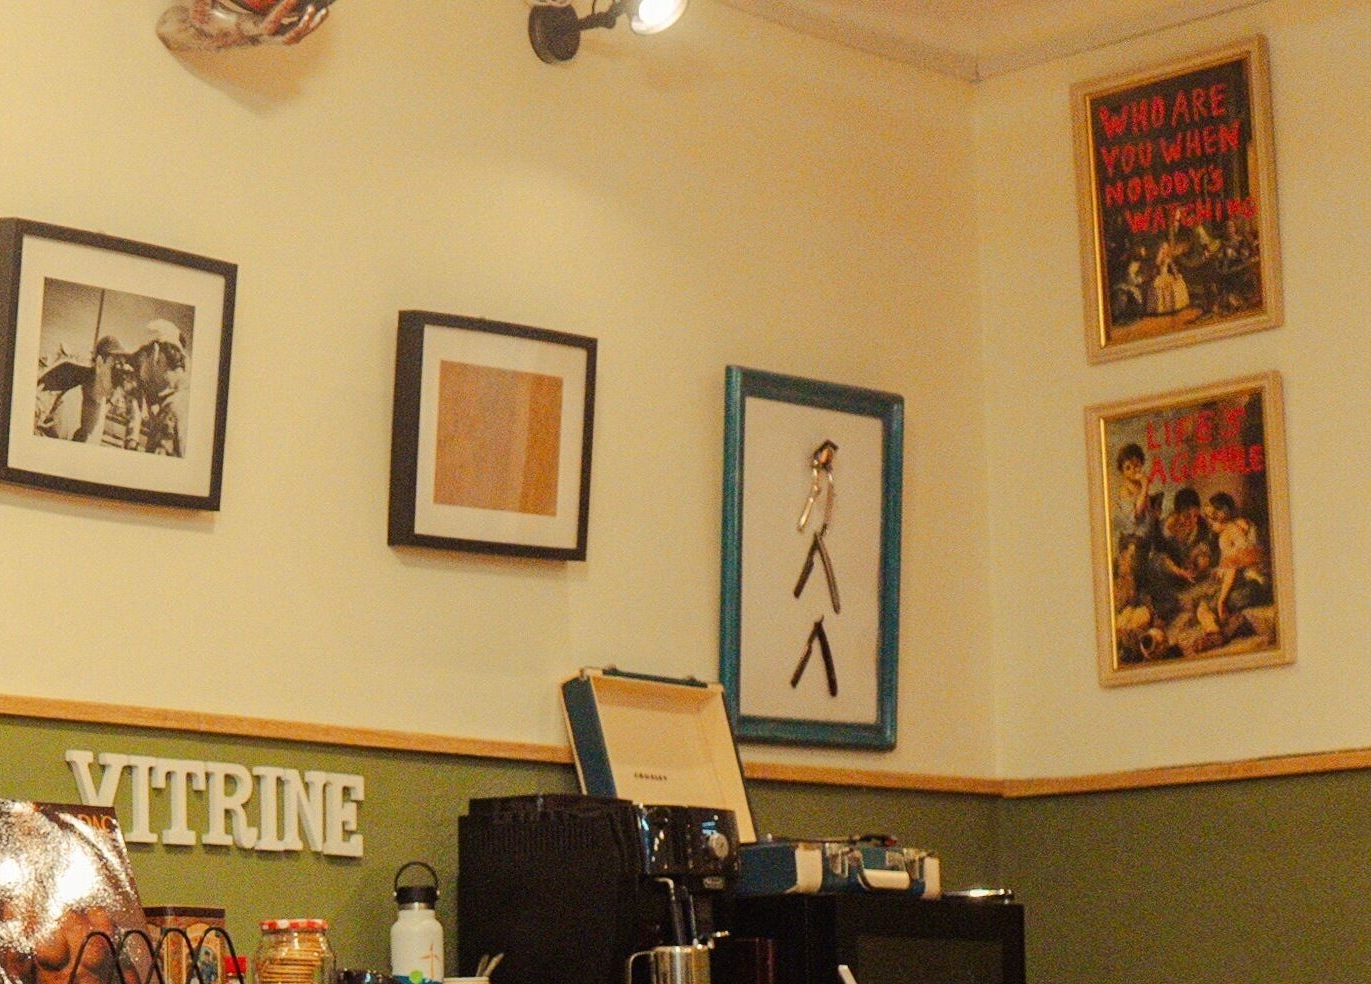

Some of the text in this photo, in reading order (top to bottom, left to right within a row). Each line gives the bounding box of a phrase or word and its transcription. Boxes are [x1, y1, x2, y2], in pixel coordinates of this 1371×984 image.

[1100, 84, 1226, 138] WHO ARE
[1102, 120, 1241, 175] YOU WHEN
[65, 749, 364, 857] VITRINE
